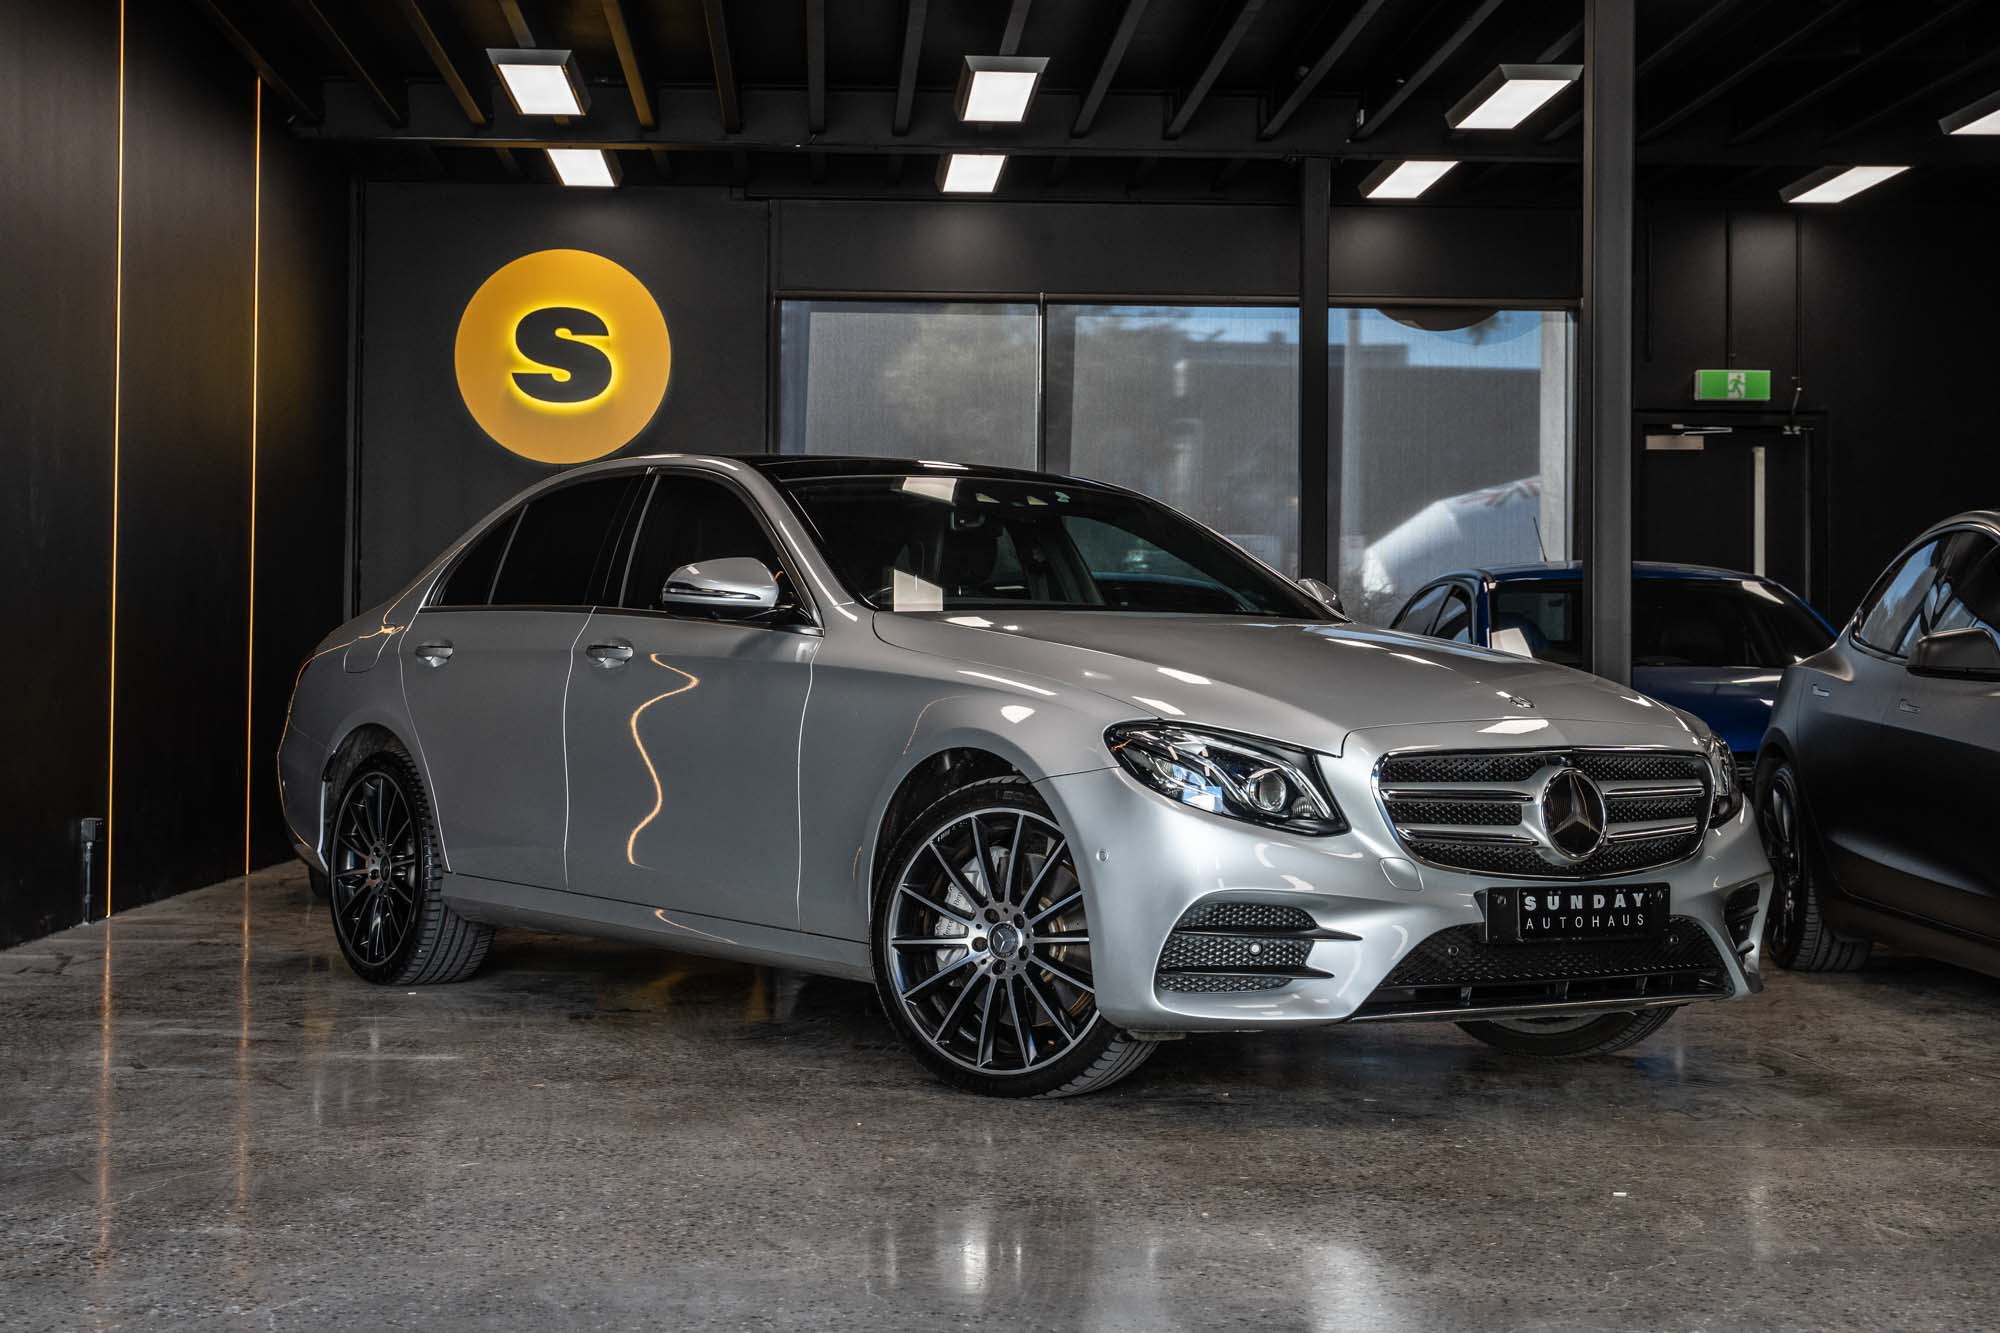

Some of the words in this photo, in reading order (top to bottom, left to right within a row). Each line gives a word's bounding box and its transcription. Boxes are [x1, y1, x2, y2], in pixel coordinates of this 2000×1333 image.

[512, 307, 612, 403] S
[1524, 892, 1644, 911] SUNDAY
[1526, 913, 1644, 930] AUTOHAUS
